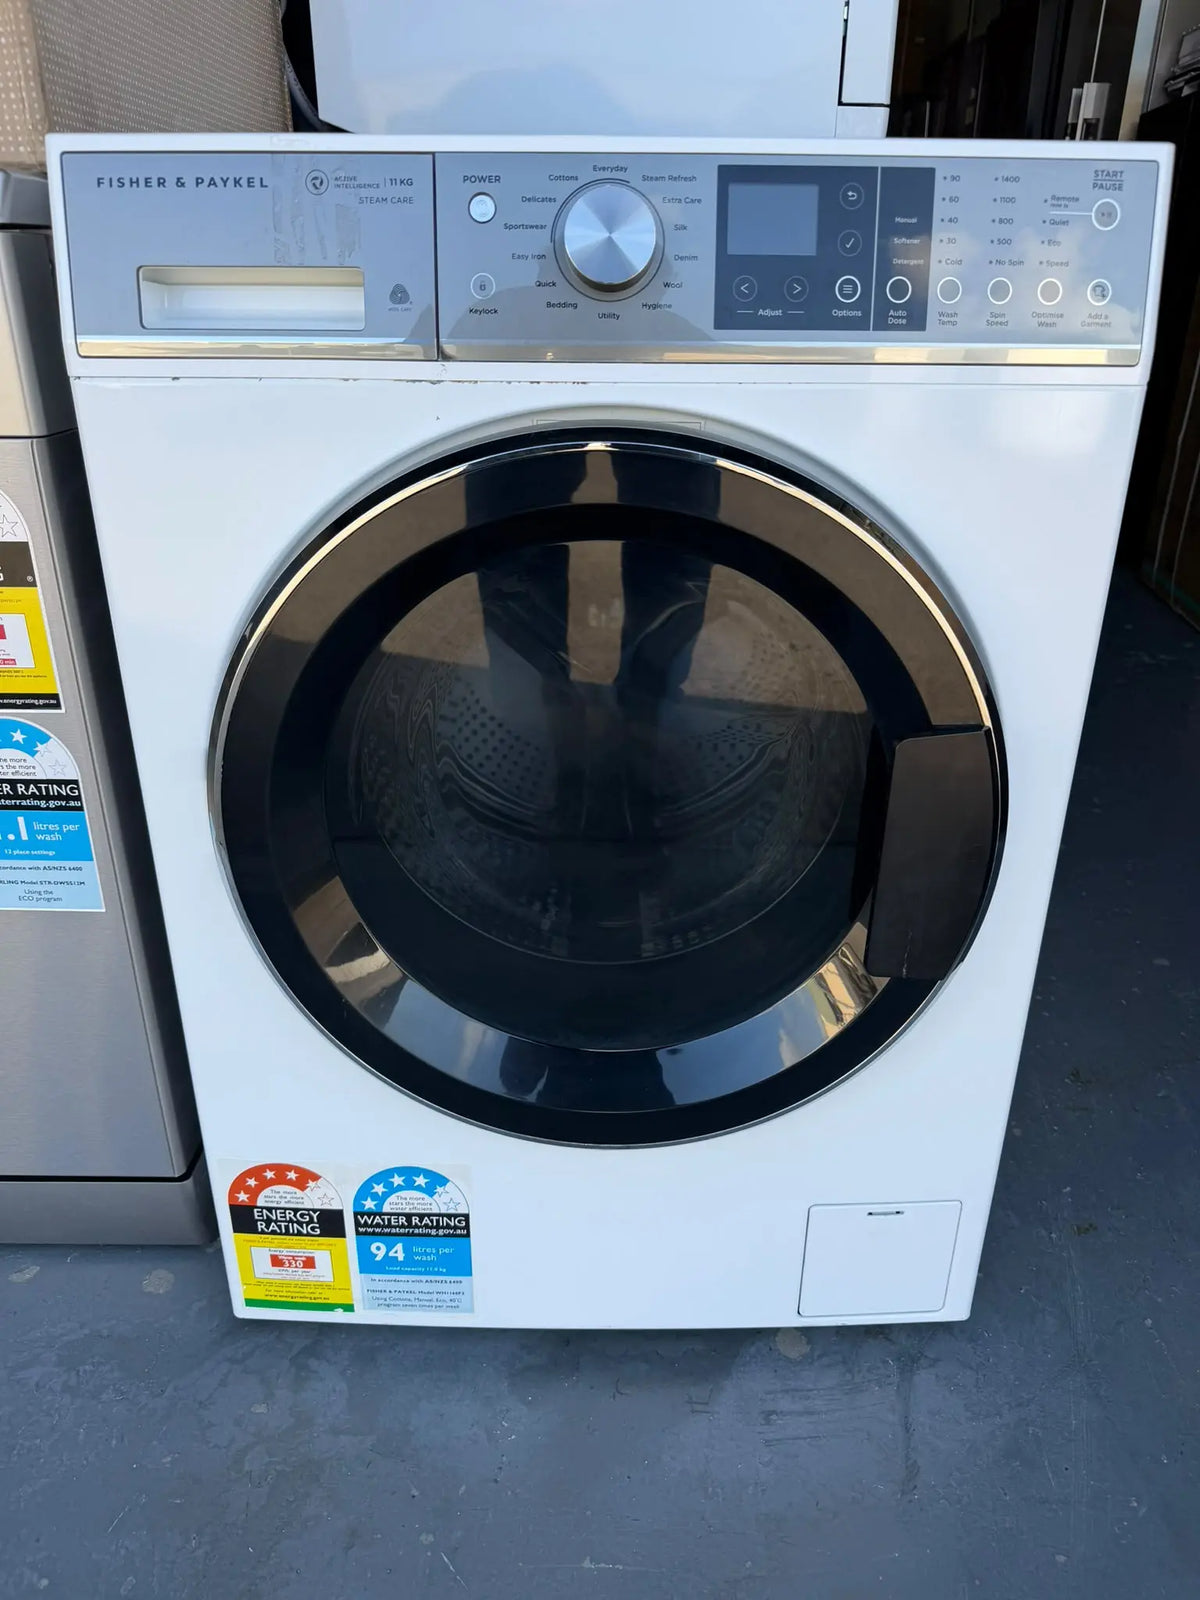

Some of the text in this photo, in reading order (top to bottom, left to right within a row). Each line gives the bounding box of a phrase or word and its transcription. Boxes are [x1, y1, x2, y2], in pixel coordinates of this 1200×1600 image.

[592, 165, 628, 173] Everyday
[548, 174, 579, 182] Cottons
[1094, 169, 1124, 179] START
[97, 177, 269, 188] FISHER & PAYKEL
[389, 178, 414, 187] 11 KG
[463, 175, 501, 184] POWER
[641, 175, 696, 183] Steam Refresh
[1092, 183, 1124, 191] PAUSE
[359, 196, 414, 205] STEAM CARE
[1051, 194, 1080, 202] Remote
[504, 223, 547, 232] Sportswear
[894, 237, 920, 245] Softener
[1048, 239, 1061, 247] Eco
[512, 253, 529, 261] Easy
[674, 254, 698, 262] Denim
[893, 258, 924, 266] Detergent
[1007, 259, 1024, 267] Spin
[1046, 260, 1069, 268] Speed
[535, 280, 557, 289] Quick
[663, 281, 683, 289] Wool
[546, 301, 578, 310] Bedding
[641, 302, 672, 311] Hygiene
[469, 307, 499, 316] Keylock
[758, 308, 783, 317] Adjust
[832, 309, 862, 317] Options
[888, 309, 907, 317] Auto
[938, 311, 959, 319] Wash
[989, 311, 1006, 320] Spin
[1032, 311, 1064, 320] Optimise
[1087, 312, 1103, 320] Add
[598, 312, 621, 321] Utility
[888, 317, 907, 325] Dose
[938, 318, 958, 327] Temp
[986, 319, 1009, 328] Speed
[1037, 320, 1057, 328] Wash
[1080, 320, 1112, 328] Garment
[17, 783, 79, 797] RATING
[33, 822, 60, 831] litres
[62, 824, 80, 833] per
[36, 832, 63, 841] wash
[253, 1208, 320, 1223] ENERGY
[357, 1215, 466, 1227] WATER RATING
[257, 1221, 320, 1235] RATING
[358, 1227, 467, 1236] www.waterrating.gov.au
[370, 1242, 455, 1261] 94 litres per
[282, 1260, 304, 1269] 330
